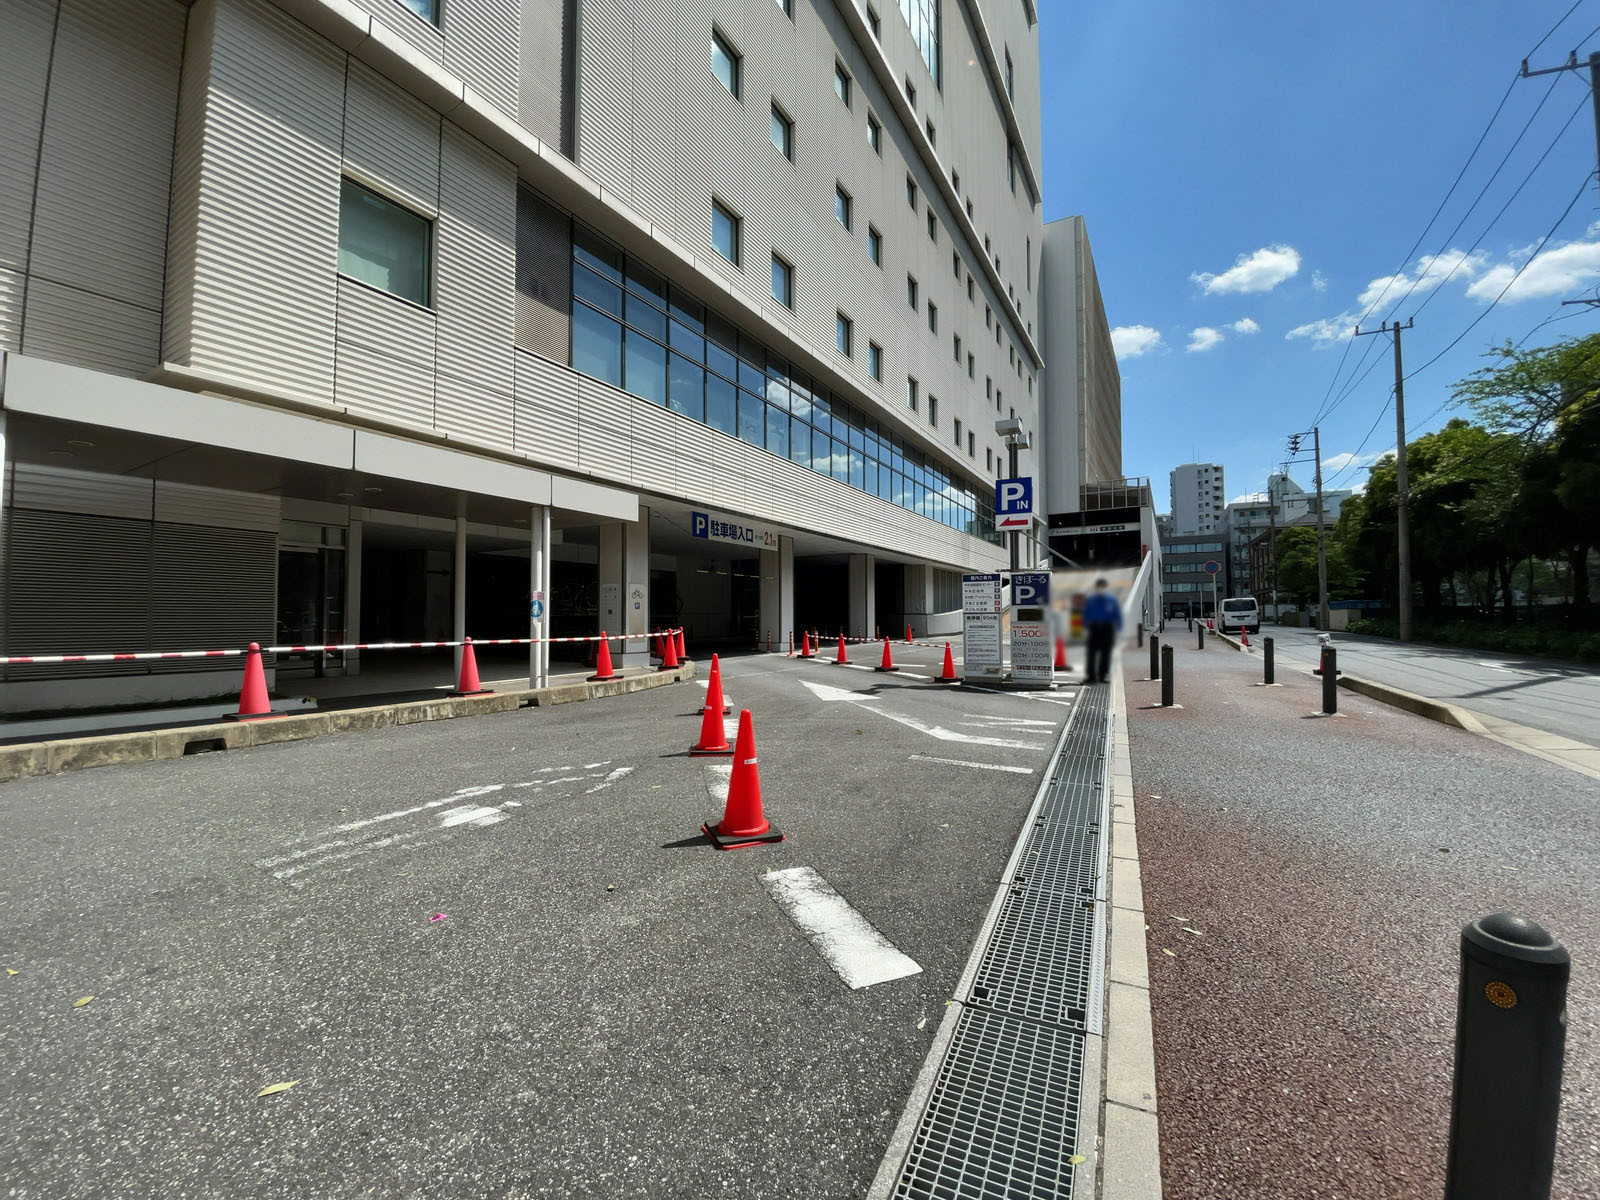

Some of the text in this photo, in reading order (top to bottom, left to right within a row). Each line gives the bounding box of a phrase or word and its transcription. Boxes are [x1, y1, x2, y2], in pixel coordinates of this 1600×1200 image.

[1001, 482, 1025, 511] P
[1016, 500, 1029, 510] IN
[696, 516, 754, 543] P 駐車場入口
[1015, 575, 1047, 585] きぼーる
[1015, 585, 1036, 605] P
